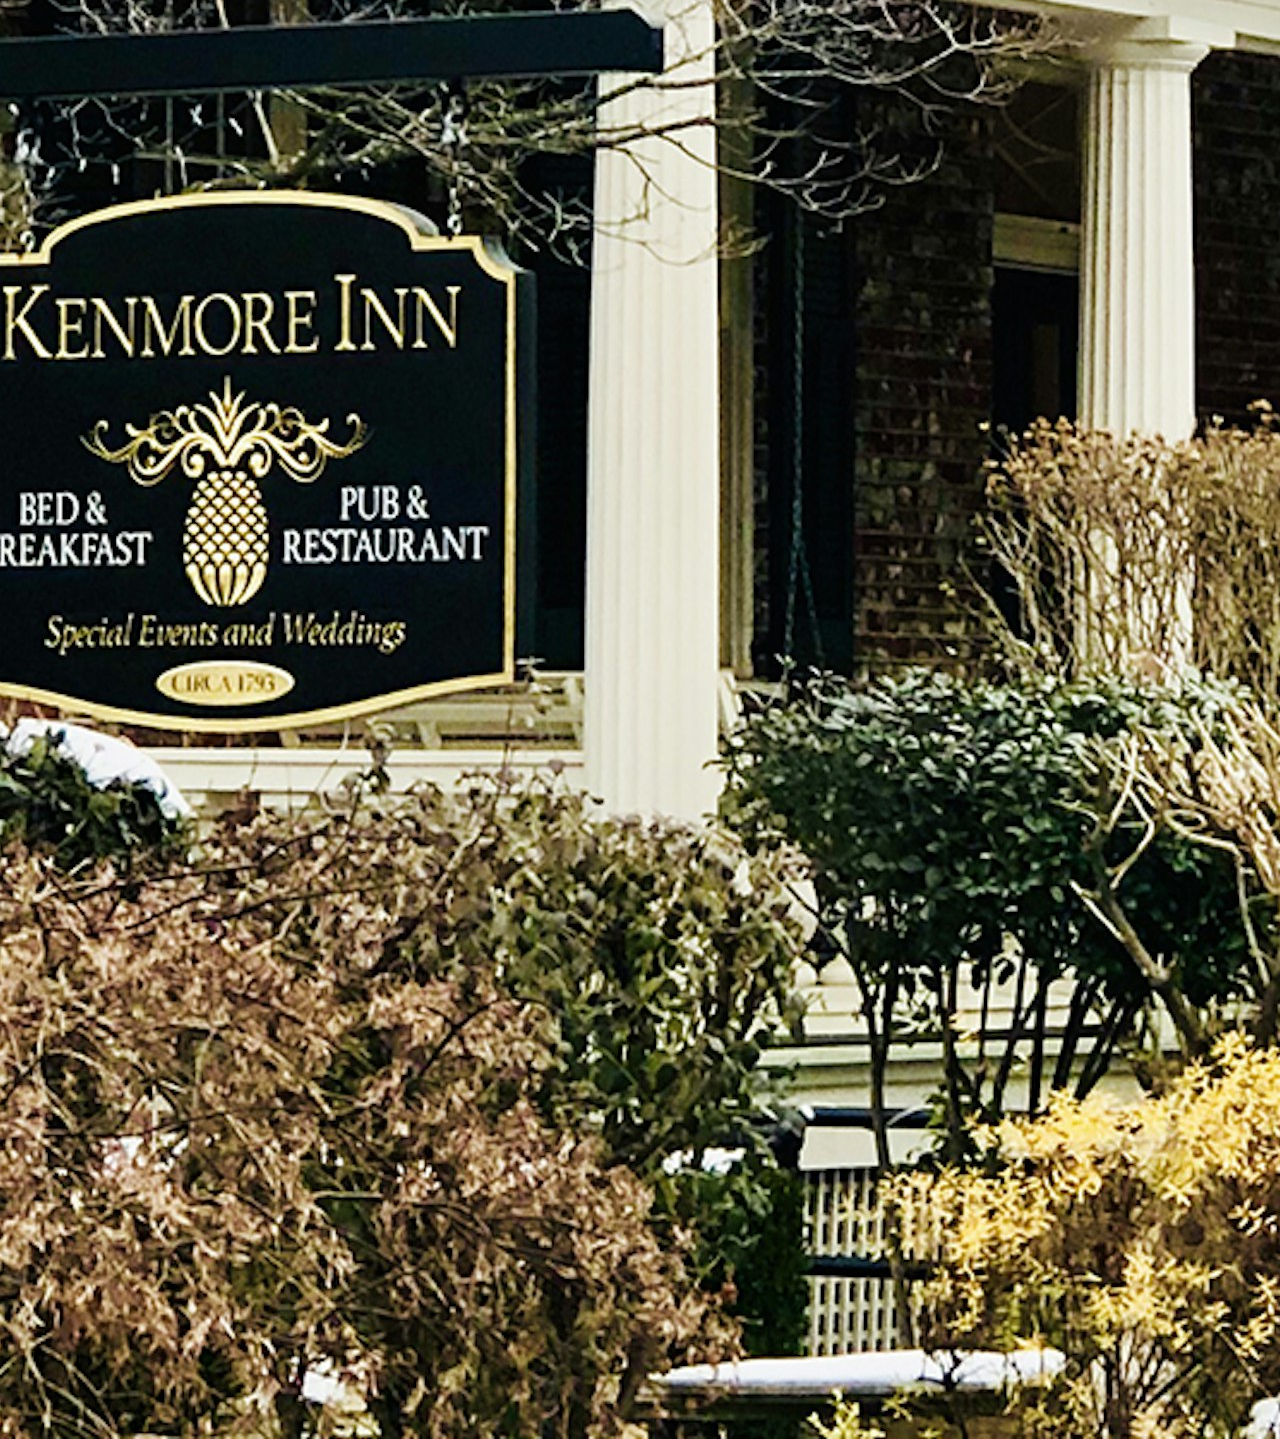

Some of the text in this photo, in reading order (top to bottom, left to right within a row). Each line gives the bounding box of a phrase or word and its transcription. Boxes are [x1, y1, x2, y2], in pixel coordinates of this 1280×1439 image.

[20, 490, 108, 526] BED &
[340, 485, 430, 521] PUB &
[283, 526, 489, 564] RESTAURANT
[44, 610, 406, 655] Special Events and Weddings
[171, 673, 276, 693] CIRCA 1793
